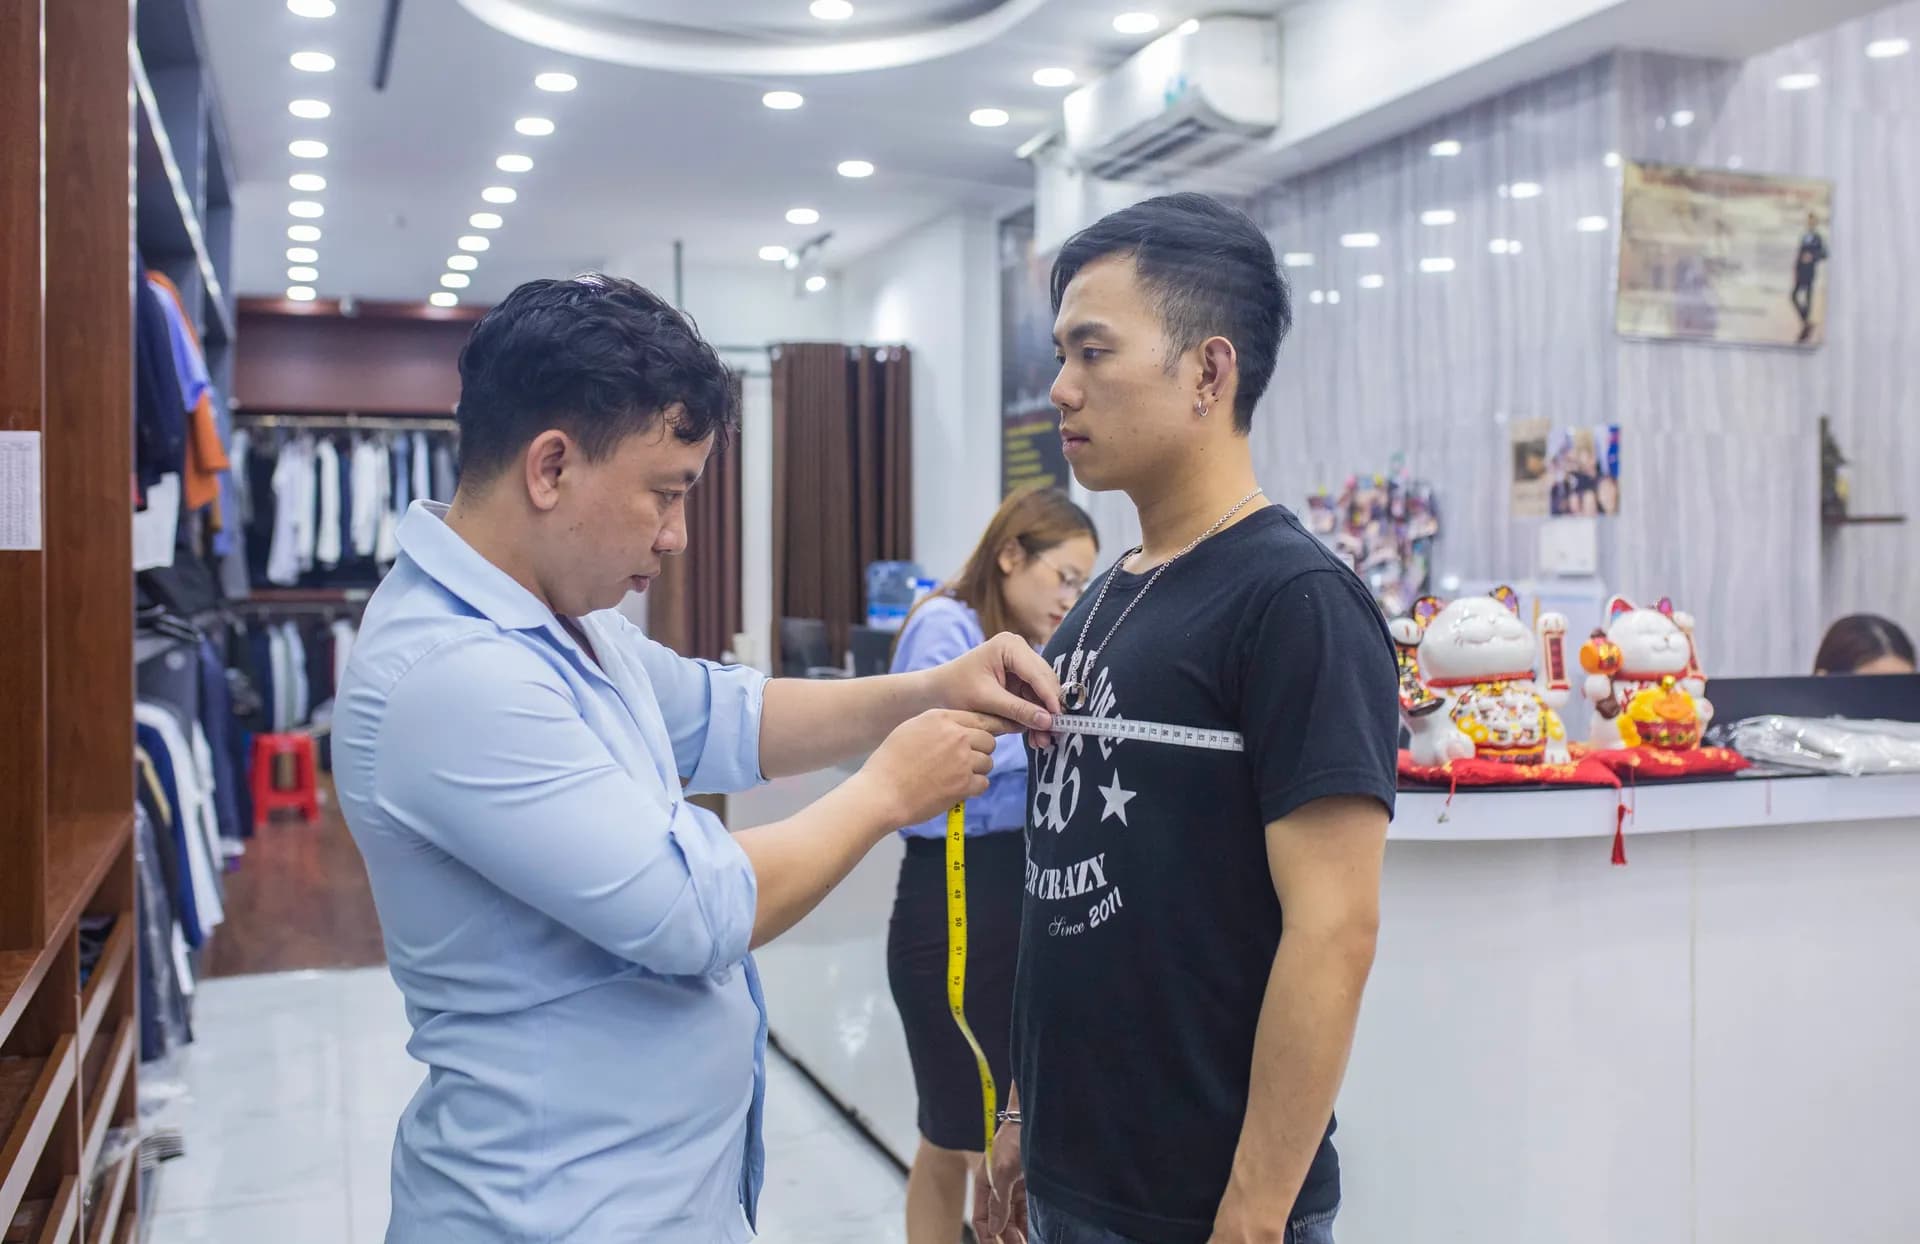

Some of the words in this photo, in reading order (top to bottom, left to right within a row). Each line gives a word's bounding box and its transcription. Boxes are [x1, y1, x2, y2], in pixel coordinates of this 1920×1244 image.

[953, 831, 960, 841] 47
[953, 861, 961, 871] 48
[1038, 852, 1107, 900] CRAZY
[954, 889, 961, 900] 49
[1048, 916, 1085, 936] Since
[1089, 886, 1123, 928] 2011
[955, 917, 962, 927] 50
[953, 976, 961, 986] 52
